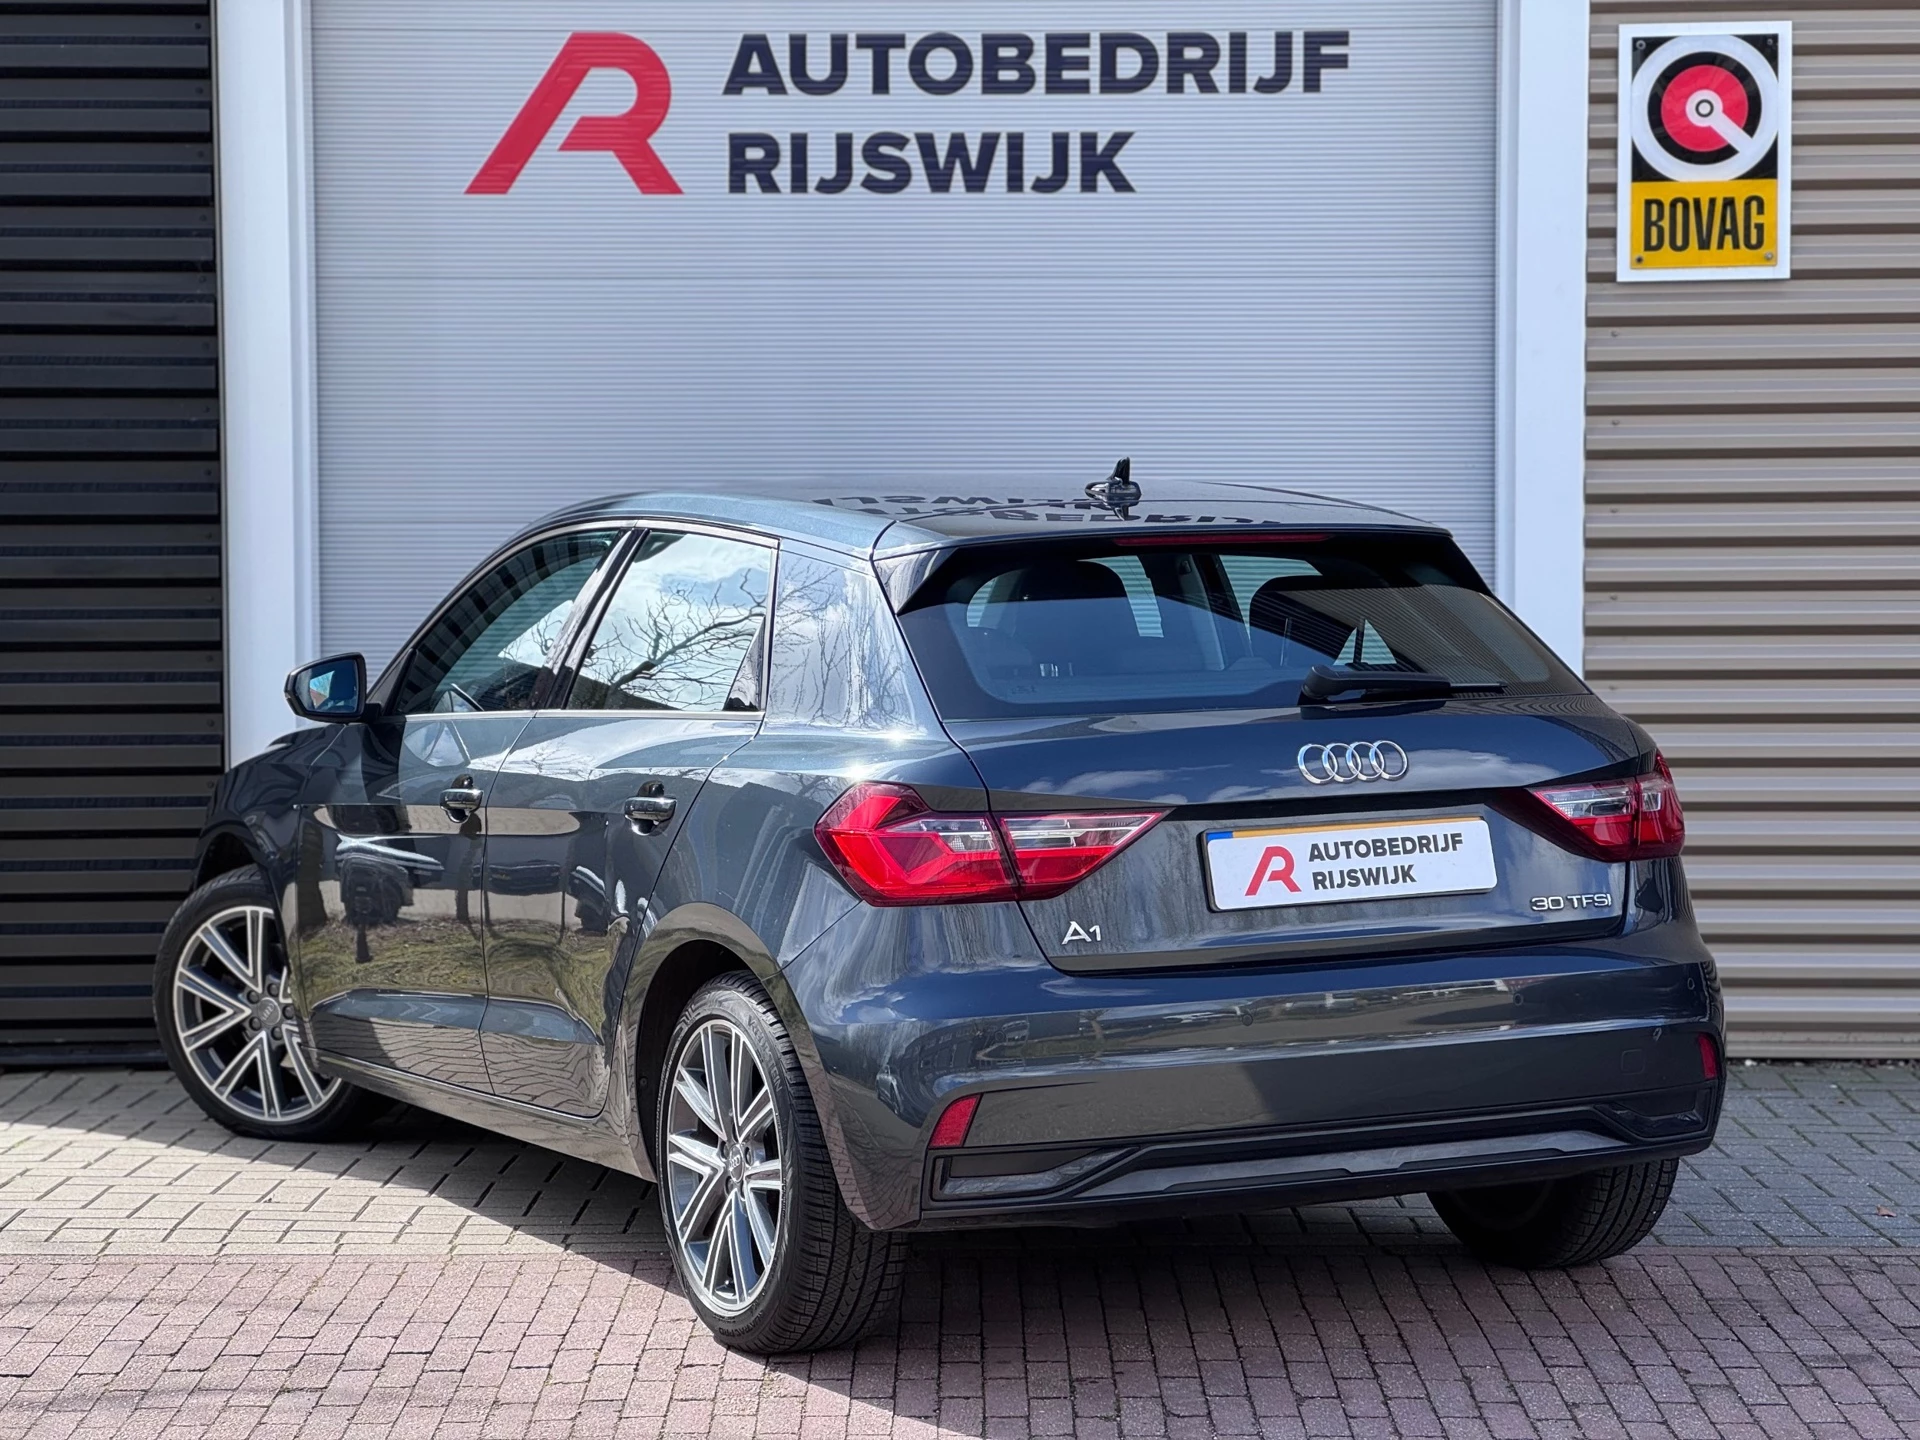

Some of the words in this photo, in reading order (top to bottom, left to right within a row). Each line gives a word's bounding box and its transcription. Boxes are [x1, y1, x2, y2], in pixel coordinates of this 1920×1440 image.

[722, 30, 1350, 96] AUTOBEDRIJF
[728, 131, 1137, 195] RIJSWIJK
[1643, 194, 1765, 253] BOVAG
[1308, 832, 1464, 863] AUTOBEDRIJF
[1312, 864, 1417, 891] RIJSWIJK
[1530, 896, 1564, 911] 30
[1566, 893, 1612, 909] TFSI
[1061, 920, 1102, 945] A1
